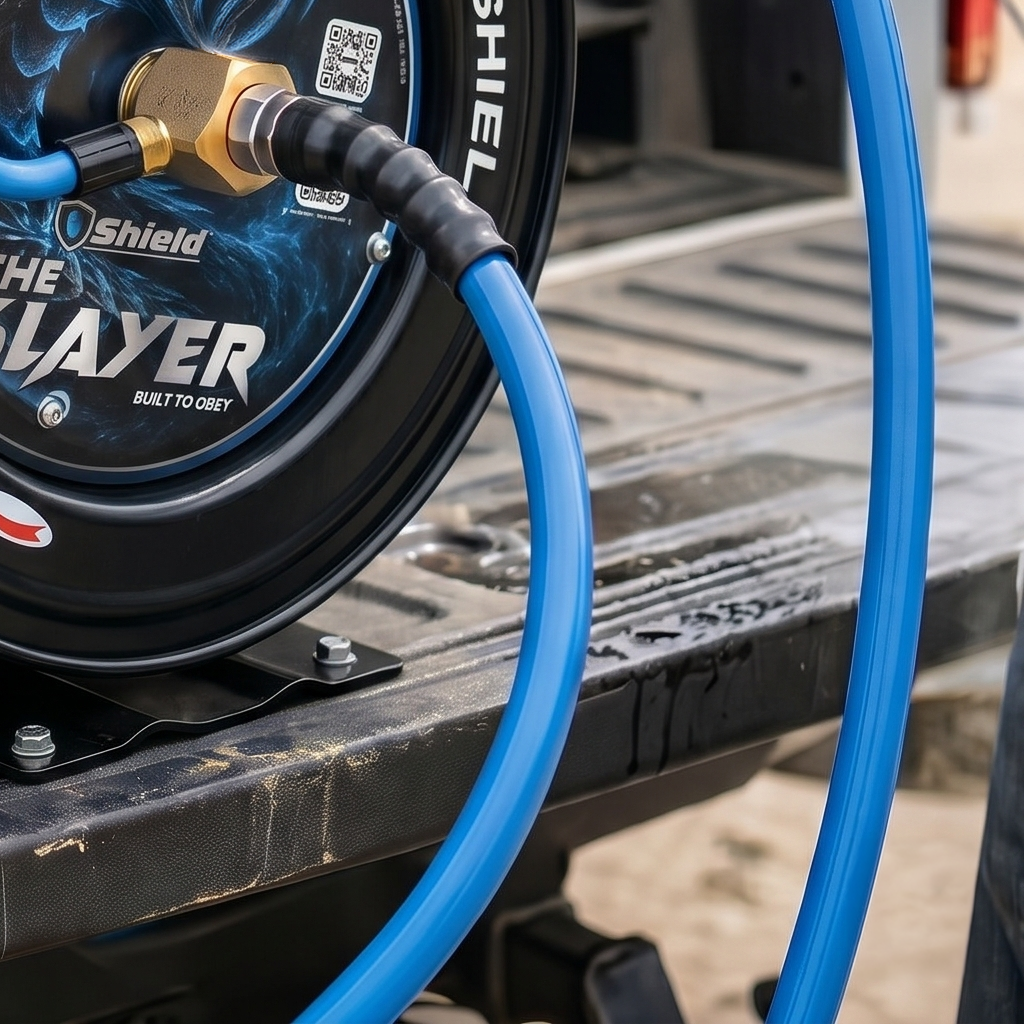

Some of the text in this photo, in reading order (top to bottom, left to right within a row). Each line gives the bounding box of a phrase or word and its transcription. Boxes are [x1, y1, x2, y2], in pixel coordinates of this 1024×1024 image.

[89, 217, 208, 257] Shield
[133, 391, 233, 412] BUILT TO OBEY
